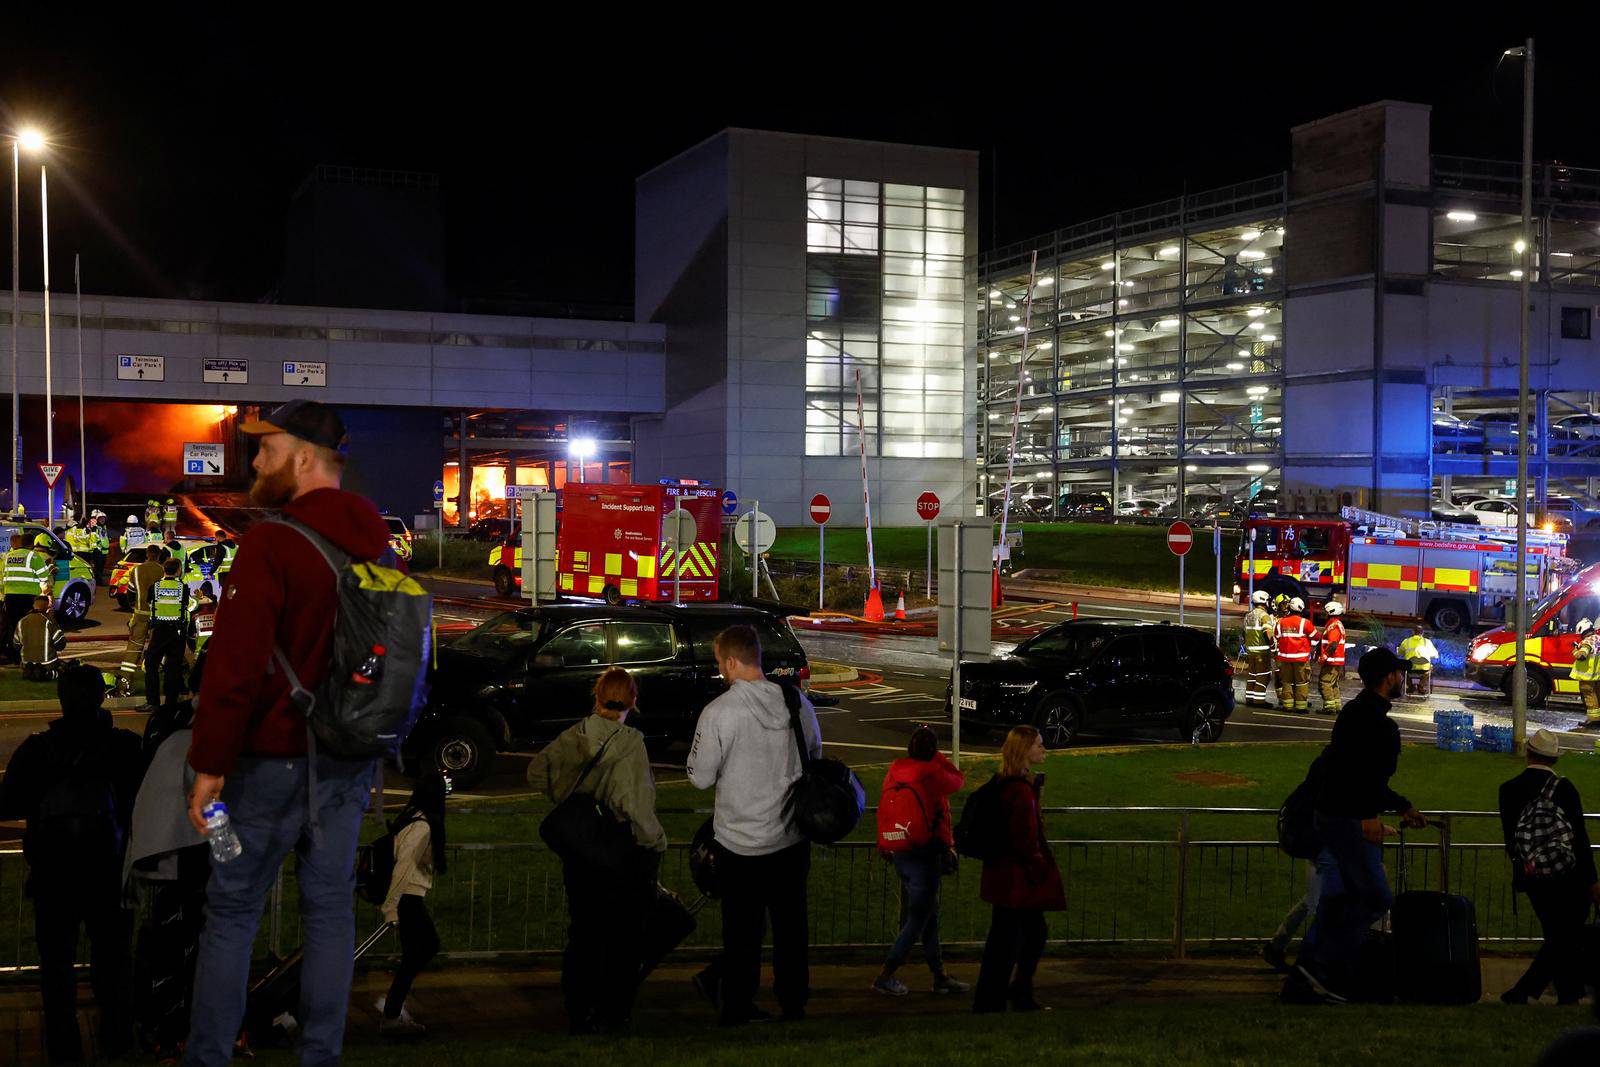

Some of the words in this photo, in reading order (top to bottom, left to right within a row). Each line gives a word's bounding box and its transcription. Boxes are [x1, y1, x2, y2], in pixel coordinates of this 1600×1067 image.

[666, 488, 680, 496] FIRE
[696, 489, 717, 497] RESCUE
[623, 504, 643, 512] Support
[918, 502, 939, 510] STOP
[1284, 529, 1295, 541] 75
[158, 589, 180, 597] POLICE
